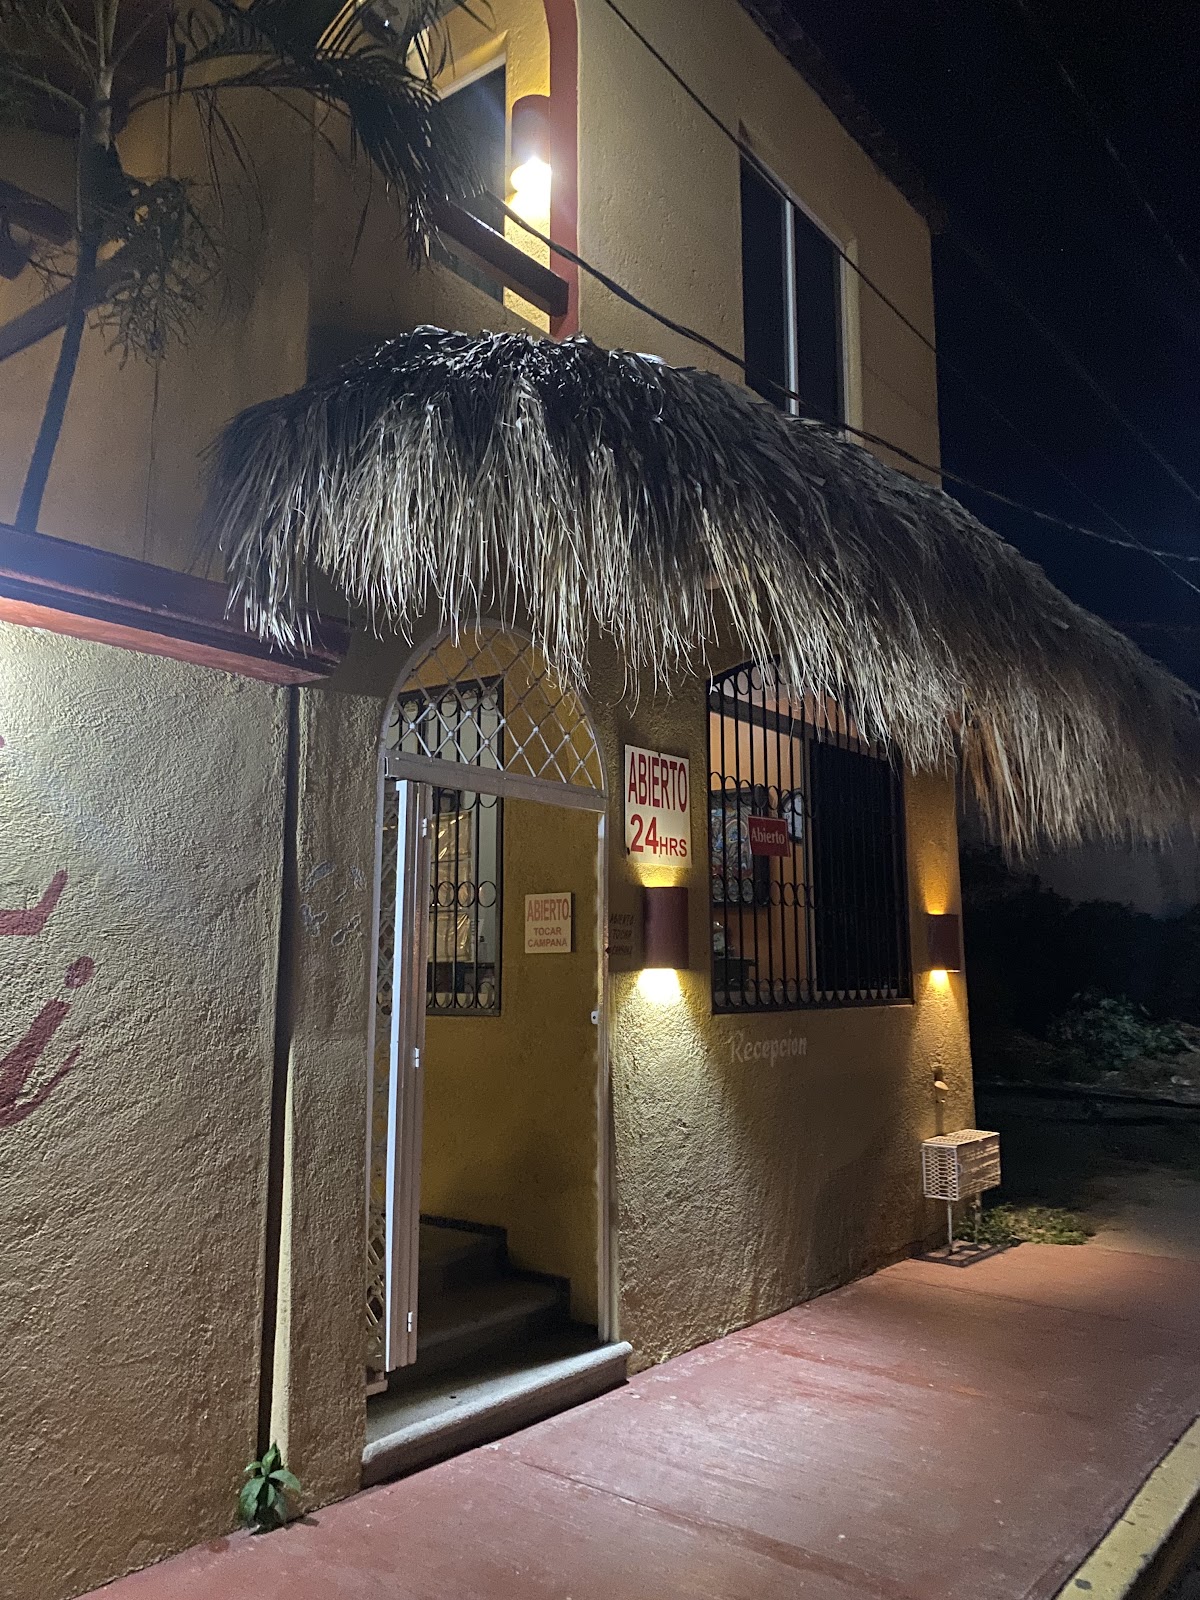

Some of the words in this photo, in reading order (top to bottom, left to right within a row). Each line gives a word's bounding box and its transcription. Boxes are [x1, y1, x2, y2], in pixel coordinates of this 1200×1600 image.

[628, 752, 687, 813] ABIERTO
[751, 827, 785, 845] Abierto
[527, 898, 570, 922] ABIERTO
[533, 927, 562, 936] TOCAR
[527, 938, 568, 948] CAMPANA
